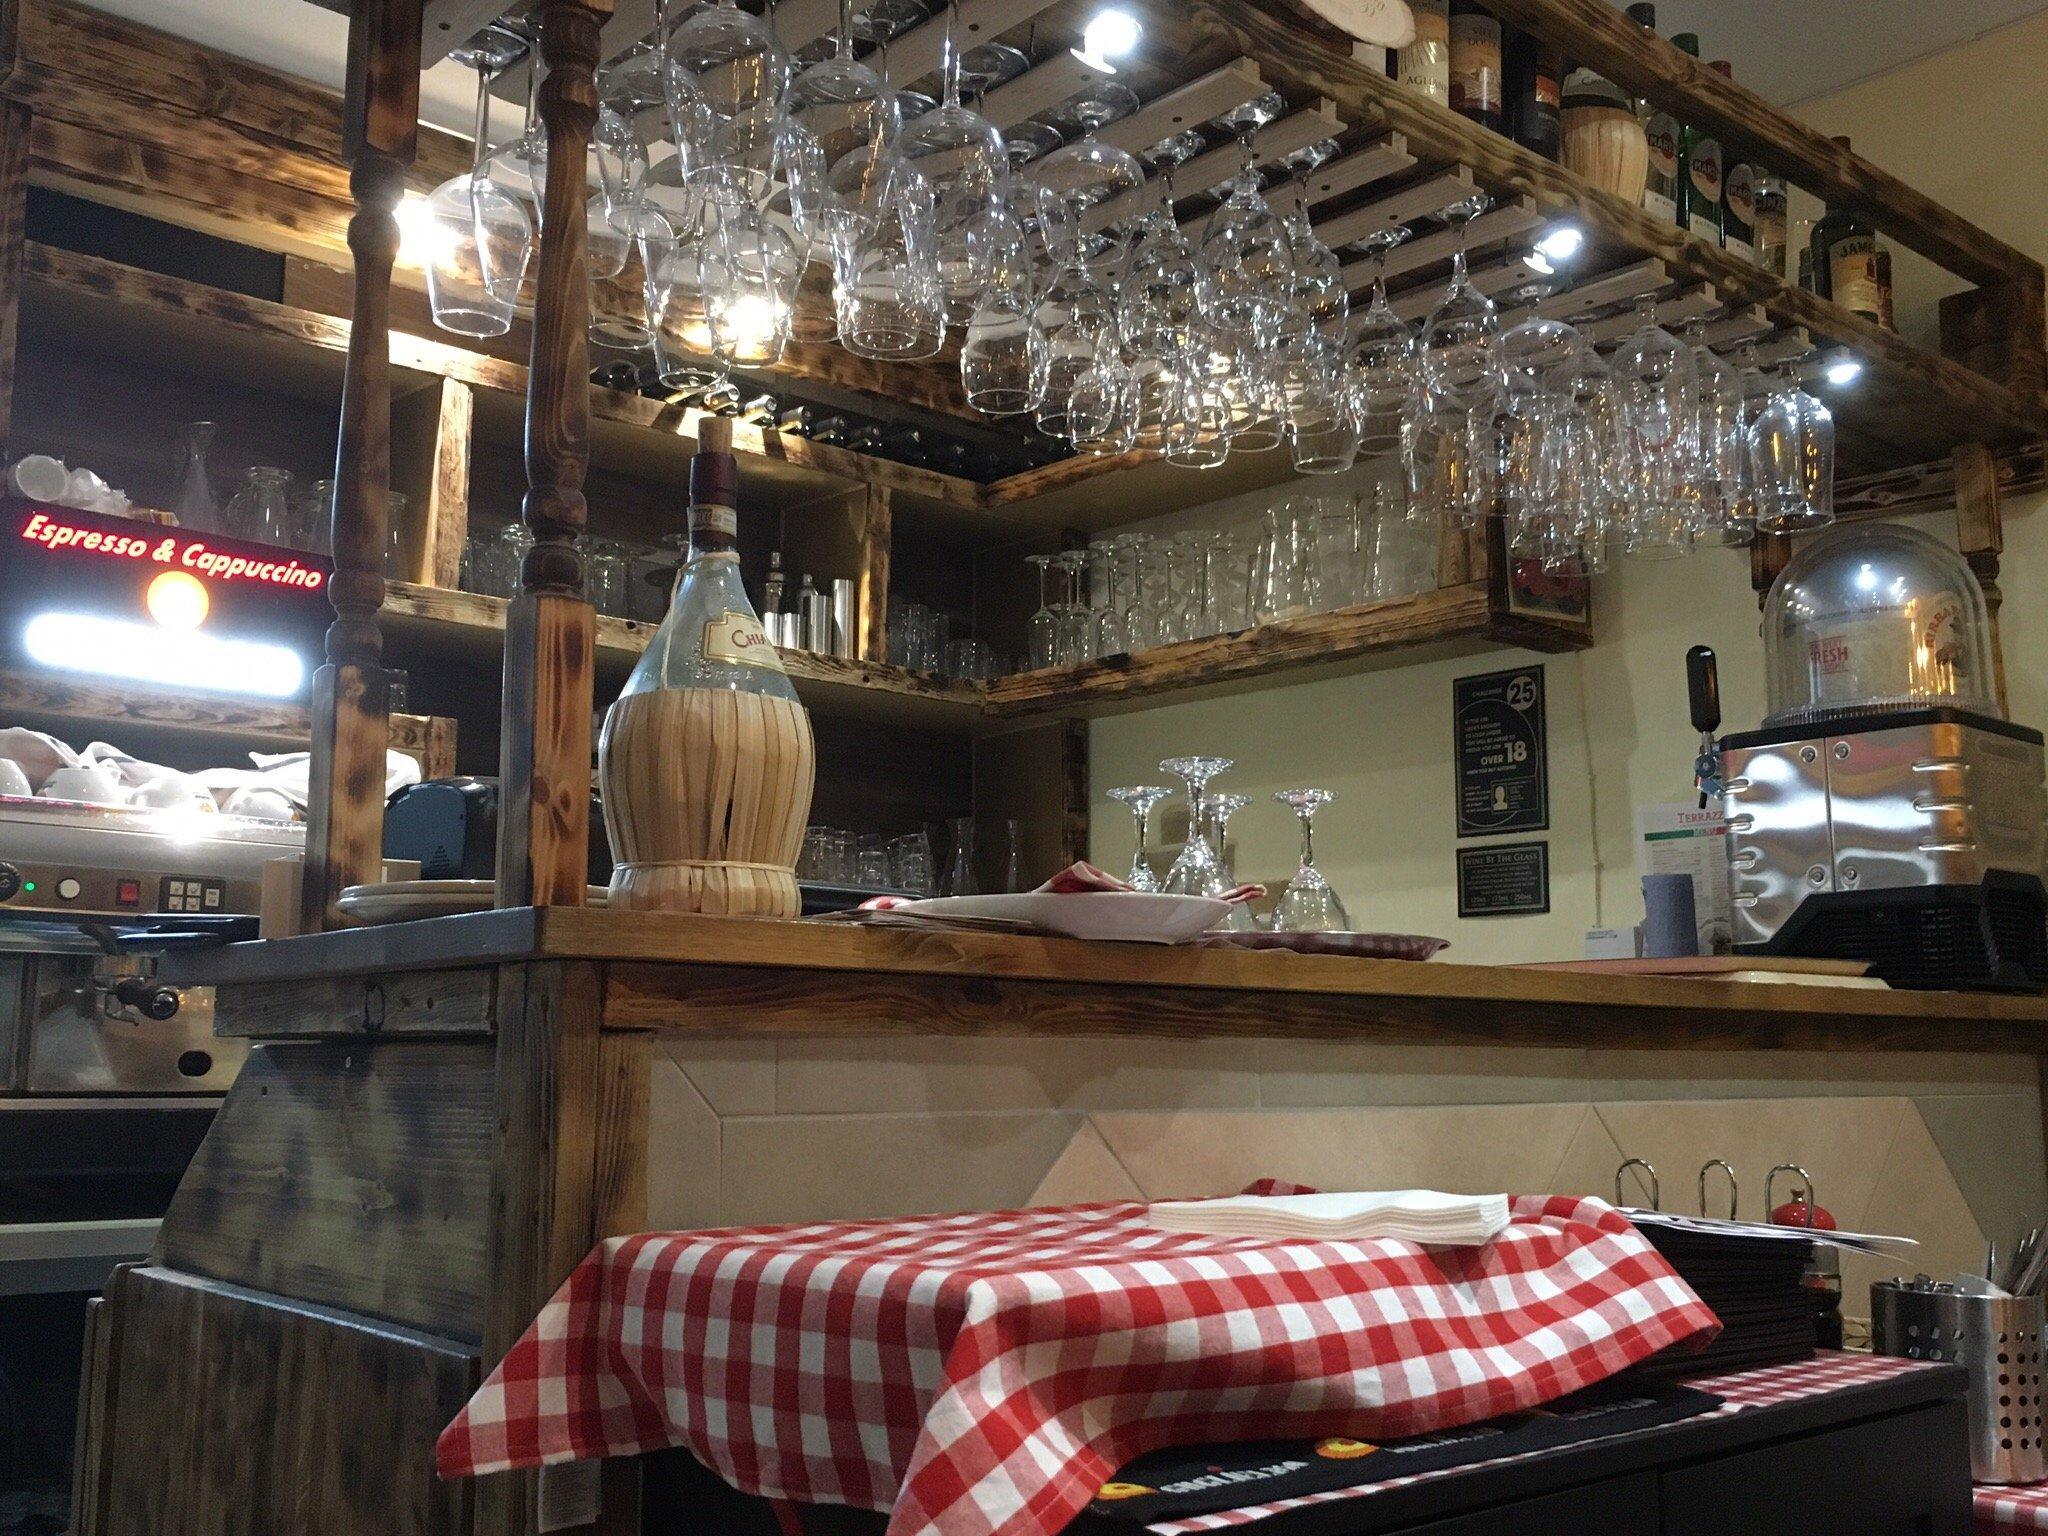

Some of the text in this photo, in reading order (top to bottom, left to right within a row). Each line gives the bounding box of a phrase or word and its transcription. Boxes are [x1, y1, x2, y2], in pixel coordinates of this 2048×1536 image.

[22, 513, 322, 588] Espresso & Cappuccino
[1510, 682, 1534, 704] 25
[1480, 754, 1504, 766] OVER
[1503, 740, 1527, 763] 18
